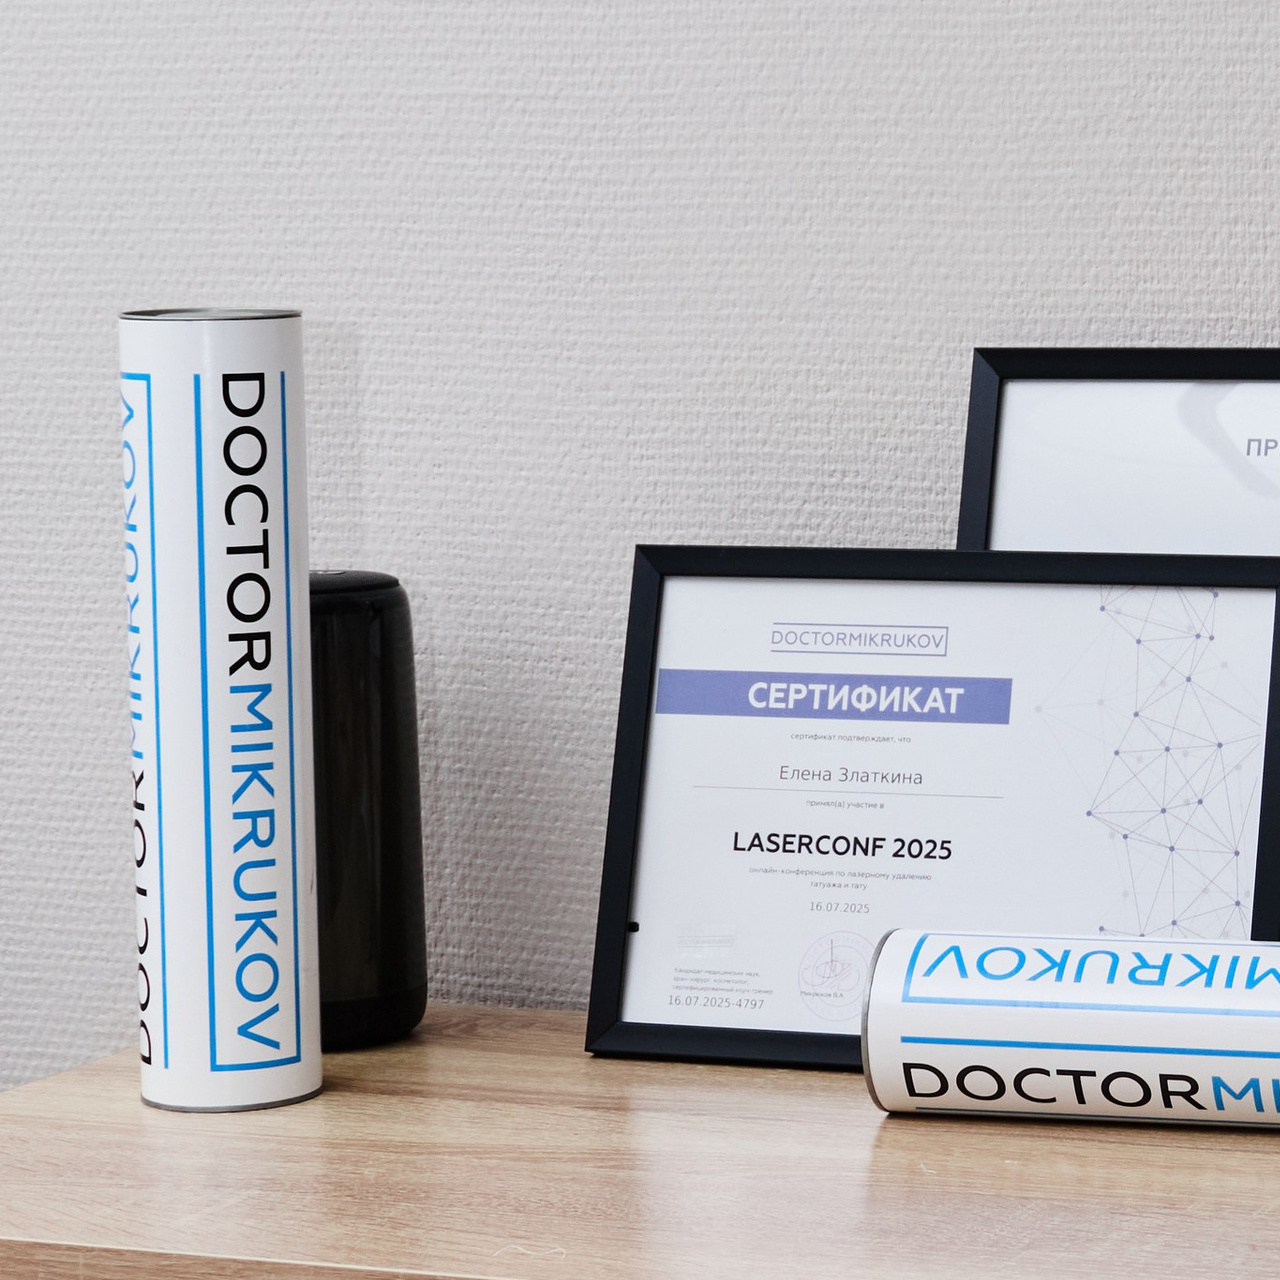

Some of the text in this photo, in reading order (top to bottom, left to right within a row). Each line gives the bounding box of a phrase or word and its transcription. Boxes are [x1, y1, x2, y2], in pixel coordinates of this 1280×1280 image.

[772, 631, 944, 648] DOCTORMIKRUKOV
[748, 682, 964, 713] СЕРТИФИКАТ
[222, 372, 281, 1050] DOCTORMIKRUKOV
[790, 733, 912, 744] сертификат подтверждает, что
[780, 766, 922, 784] Елена Златкина
[806, 800, 846, 809] принял(а)
[846, 802, 879, 810] участие
[734, 832, 951, 860] LASERCONF 2025
[835, 870, 846, 878] по
[846, 871, 890, 881] лазерному
[891, 873, 932, 881] удалению
[810, 902, 869, 913] 16.07.2025
[669, 995, 764, 1009] 16.07.2025-4797
